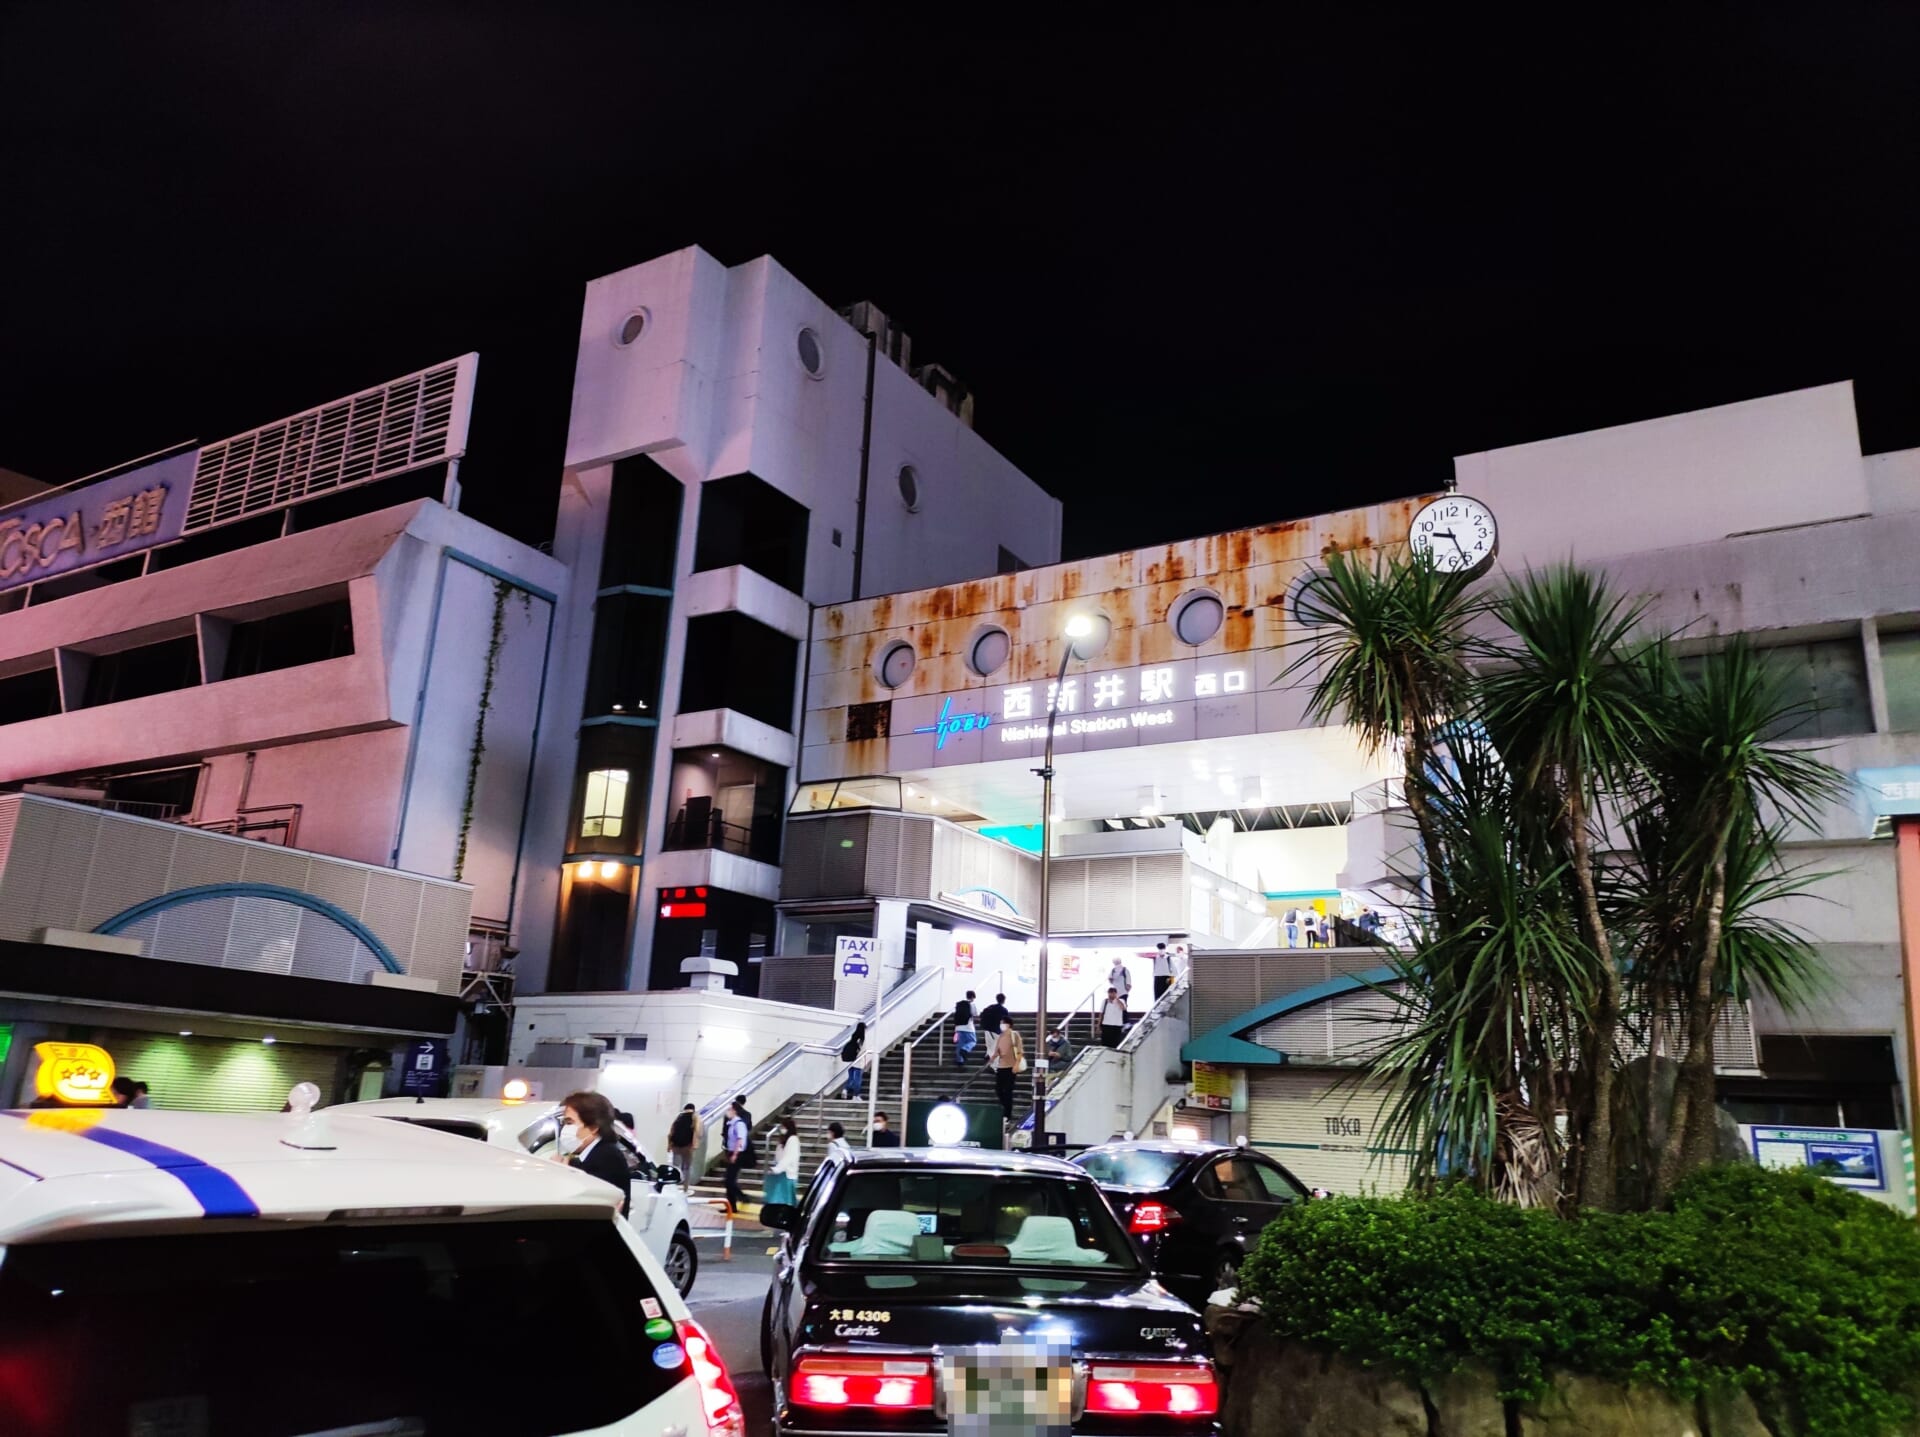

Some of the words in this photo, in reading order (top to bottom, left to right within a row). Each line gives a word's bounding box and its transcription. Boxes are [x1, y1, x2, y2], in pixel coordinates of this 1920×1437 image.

[1433, 510, 1443, 520] 11
[1446, 506, 1459, 517] 12
[1474, 515, 1482, 526] 2
[1421, 521, 1434, 532] 10
[1478, 528, 1488, 538] 3
[1418, 535, 1427, 545] 9
[1474, 541, 1483, 551] 4
[1003, 667, 1174, 719] 西新井駅
[1195, 670, 1246, 697] 西口
[1001, 724, 1067, 742] Nishiaai
[1070, 718, 1127, 735] Station
[1130, 709, 1174, 727] West
[840, 938, 874, 951] TAXI
[1324, 1115, 1361, 1136] TOSCA
[856, 1310, 891, 1322] 4306
